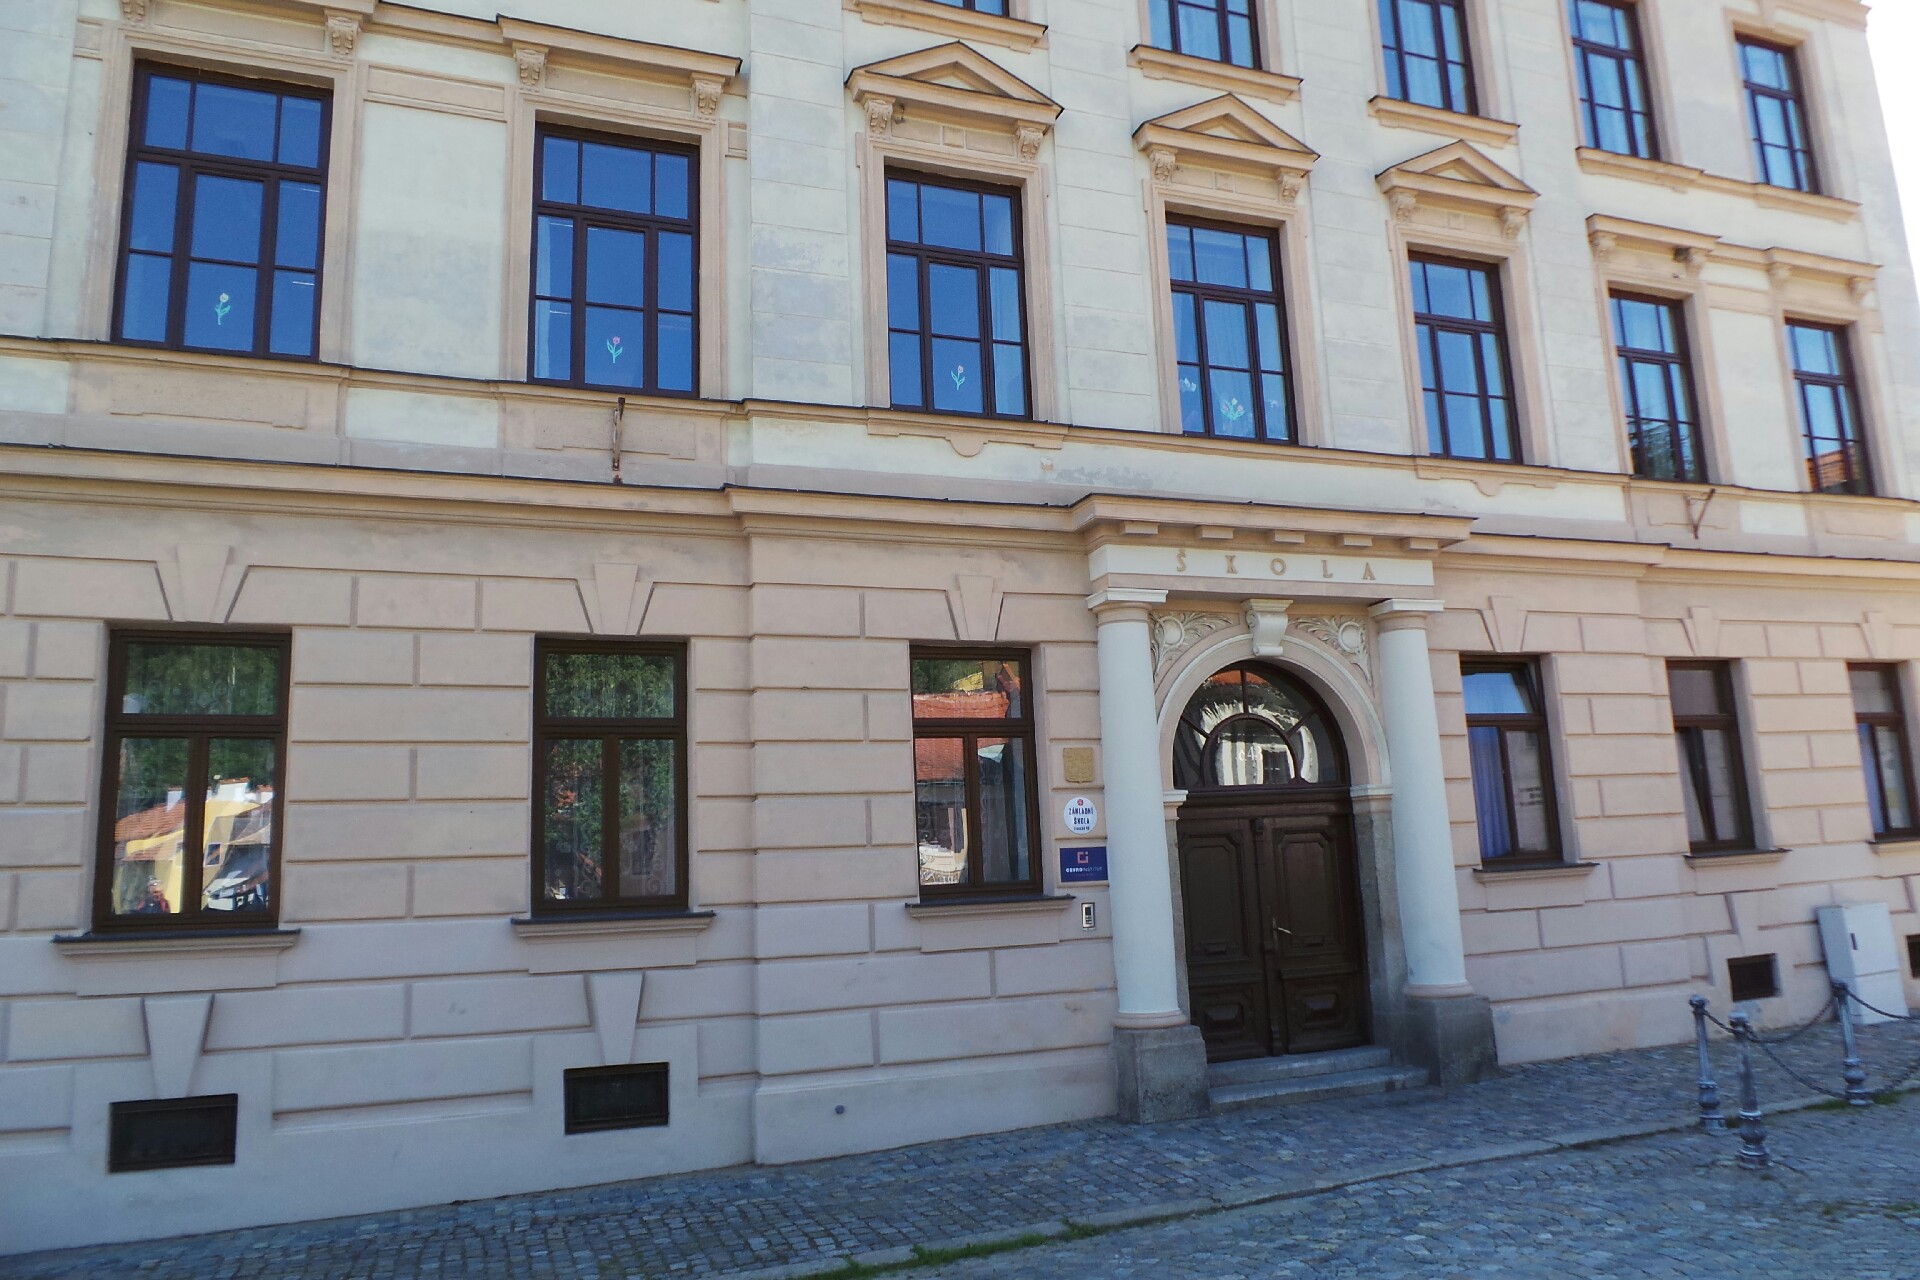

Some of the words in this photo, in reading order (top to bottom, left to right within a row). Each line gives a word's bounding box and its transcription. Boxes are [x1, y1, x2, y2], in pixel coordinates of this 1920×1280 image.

[1176, 549, 1376, 580] ŠKOLA
[1069, 807, 1093, 815] ZÁKLADNÍ
[1074, 817, 1089, 825] ŠKOLA
